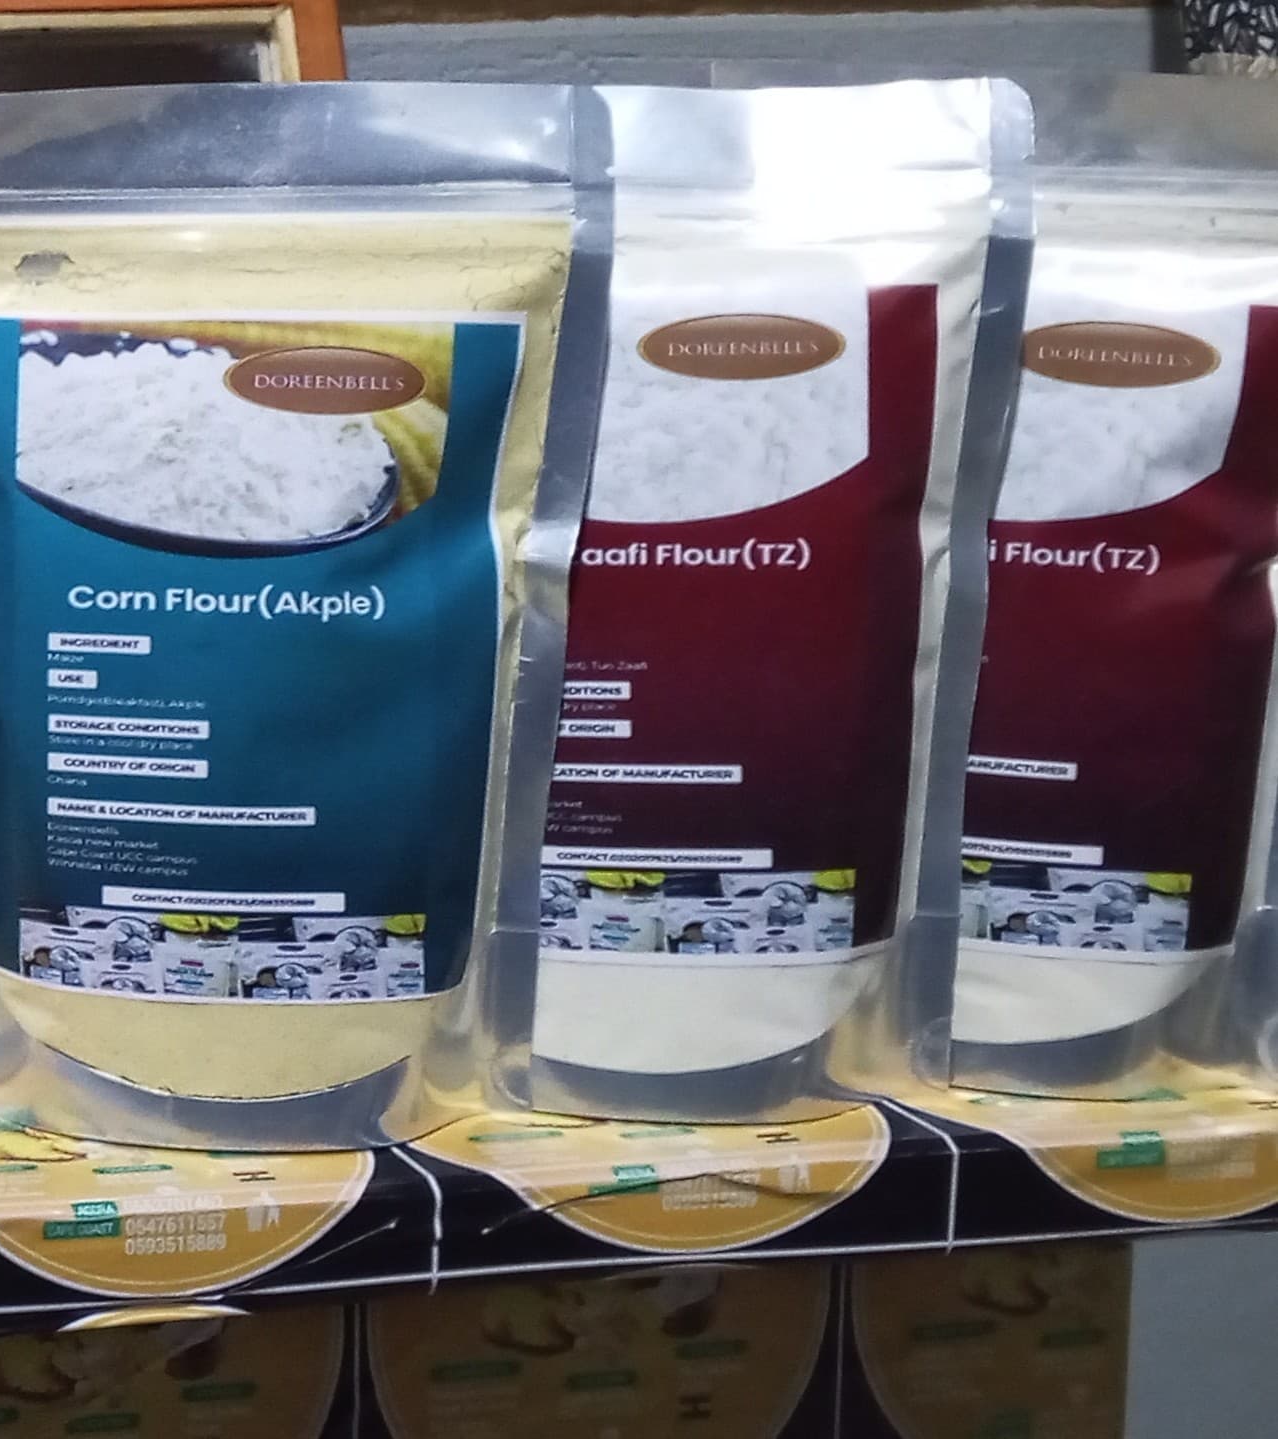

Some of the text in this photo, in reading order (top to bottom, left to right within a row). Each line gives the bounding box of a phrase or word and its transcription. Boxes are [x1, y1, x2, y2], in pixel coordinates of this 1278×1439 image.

[582, 539, 810, 569] aafi Flour(TZ)
[1005, 542, 1160, 575] Flour(TZ)
[68, 585, 385, 623] Corn Flour(Akple)
[60, 638, 139, 649] INGREDIENT
[59, 674, 84, 684] USE
[54, 719, 200, 735] STORAGE CONDITIONS
[569, 723, 615, 734] ORIGIN
[64, 757, 195, 773] COUNTRY OF ORIGIN
[553, 768, 732, 779] CATION OF MANUFACTURER
[57, 803, 96, 814] NAME
[109, 806, 174, 818] LOCATION
[179, 809, 195, 819] OF
[199, 810, 306, 821] MANUFACTURER
